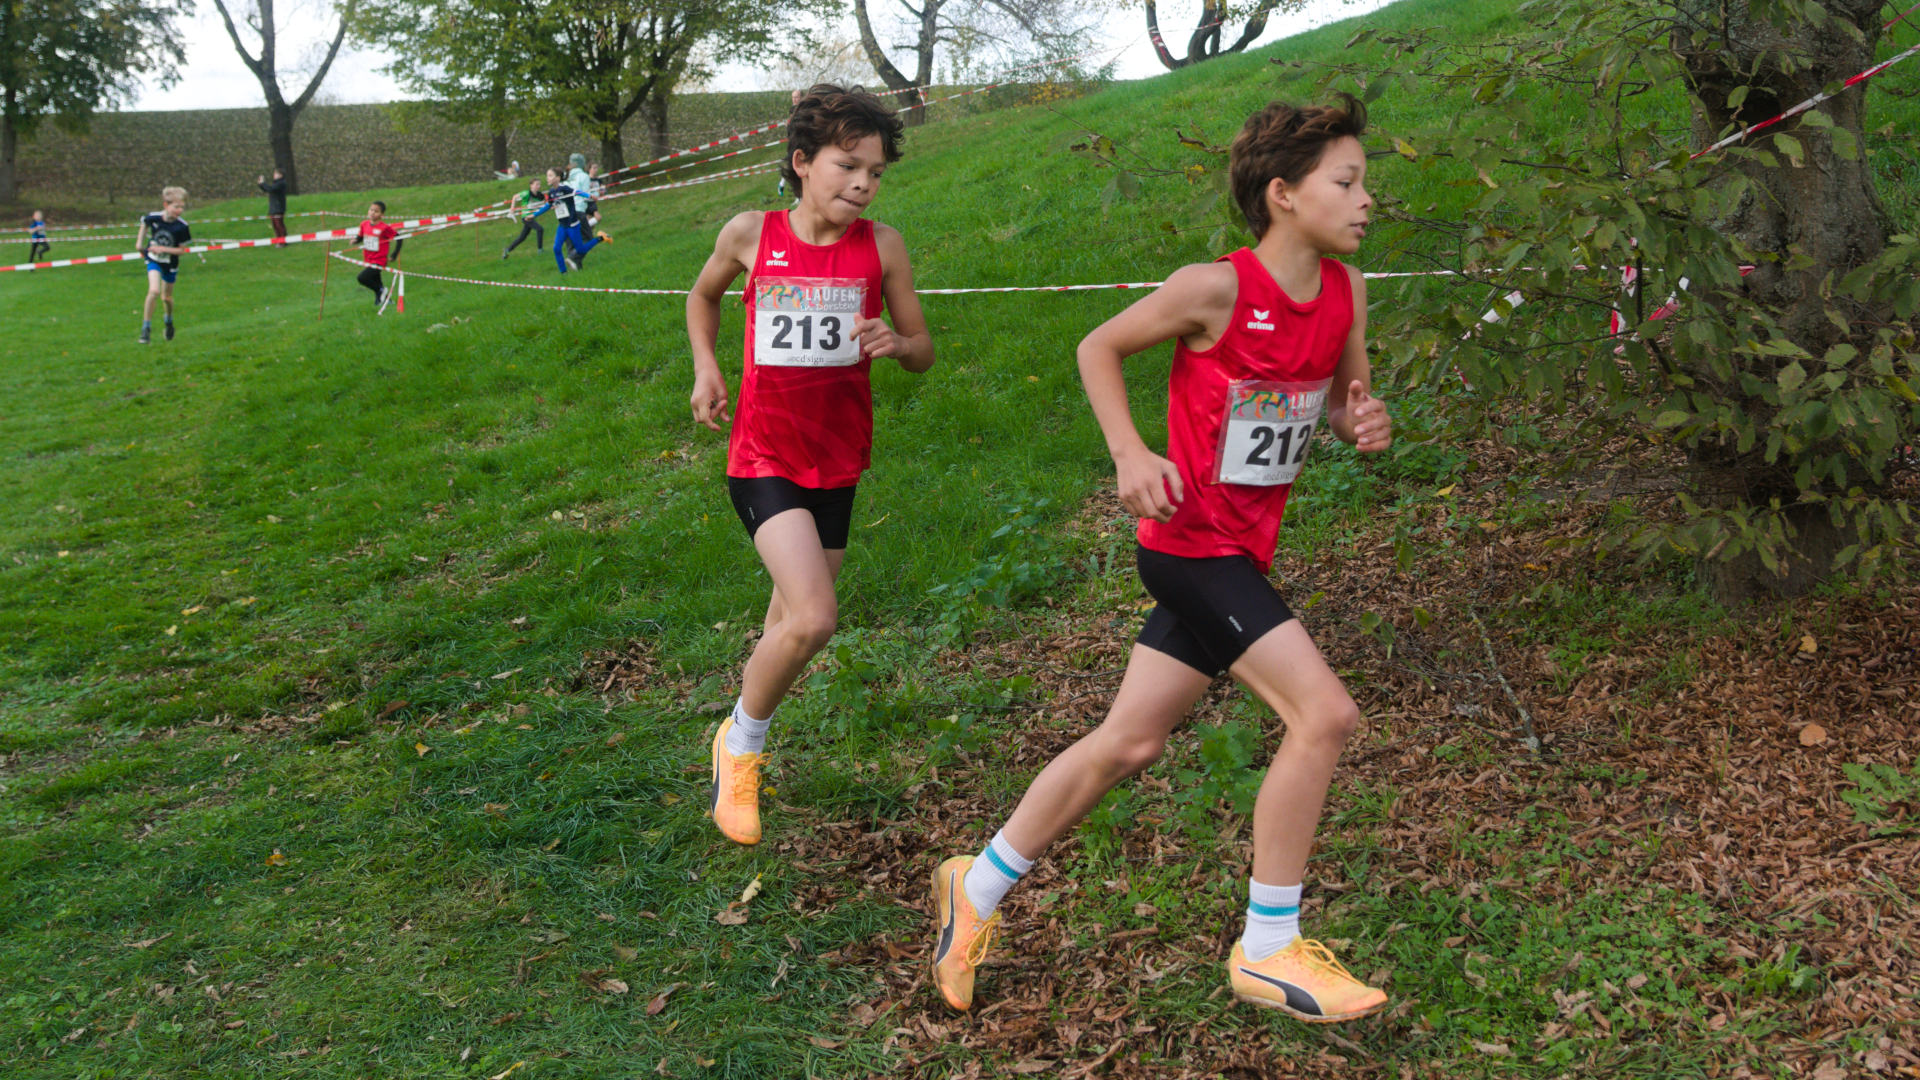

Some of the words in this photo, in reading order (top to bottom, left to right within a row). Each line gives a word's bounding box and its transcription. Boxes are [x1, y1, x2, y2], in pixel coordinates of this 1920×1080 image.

[805, 287, 856, 302] LAUFEN
[771, 315, 841, 351] 213
[1247, 321, 1274, 331] erima
[1245, 424, 1311, 466] 212
